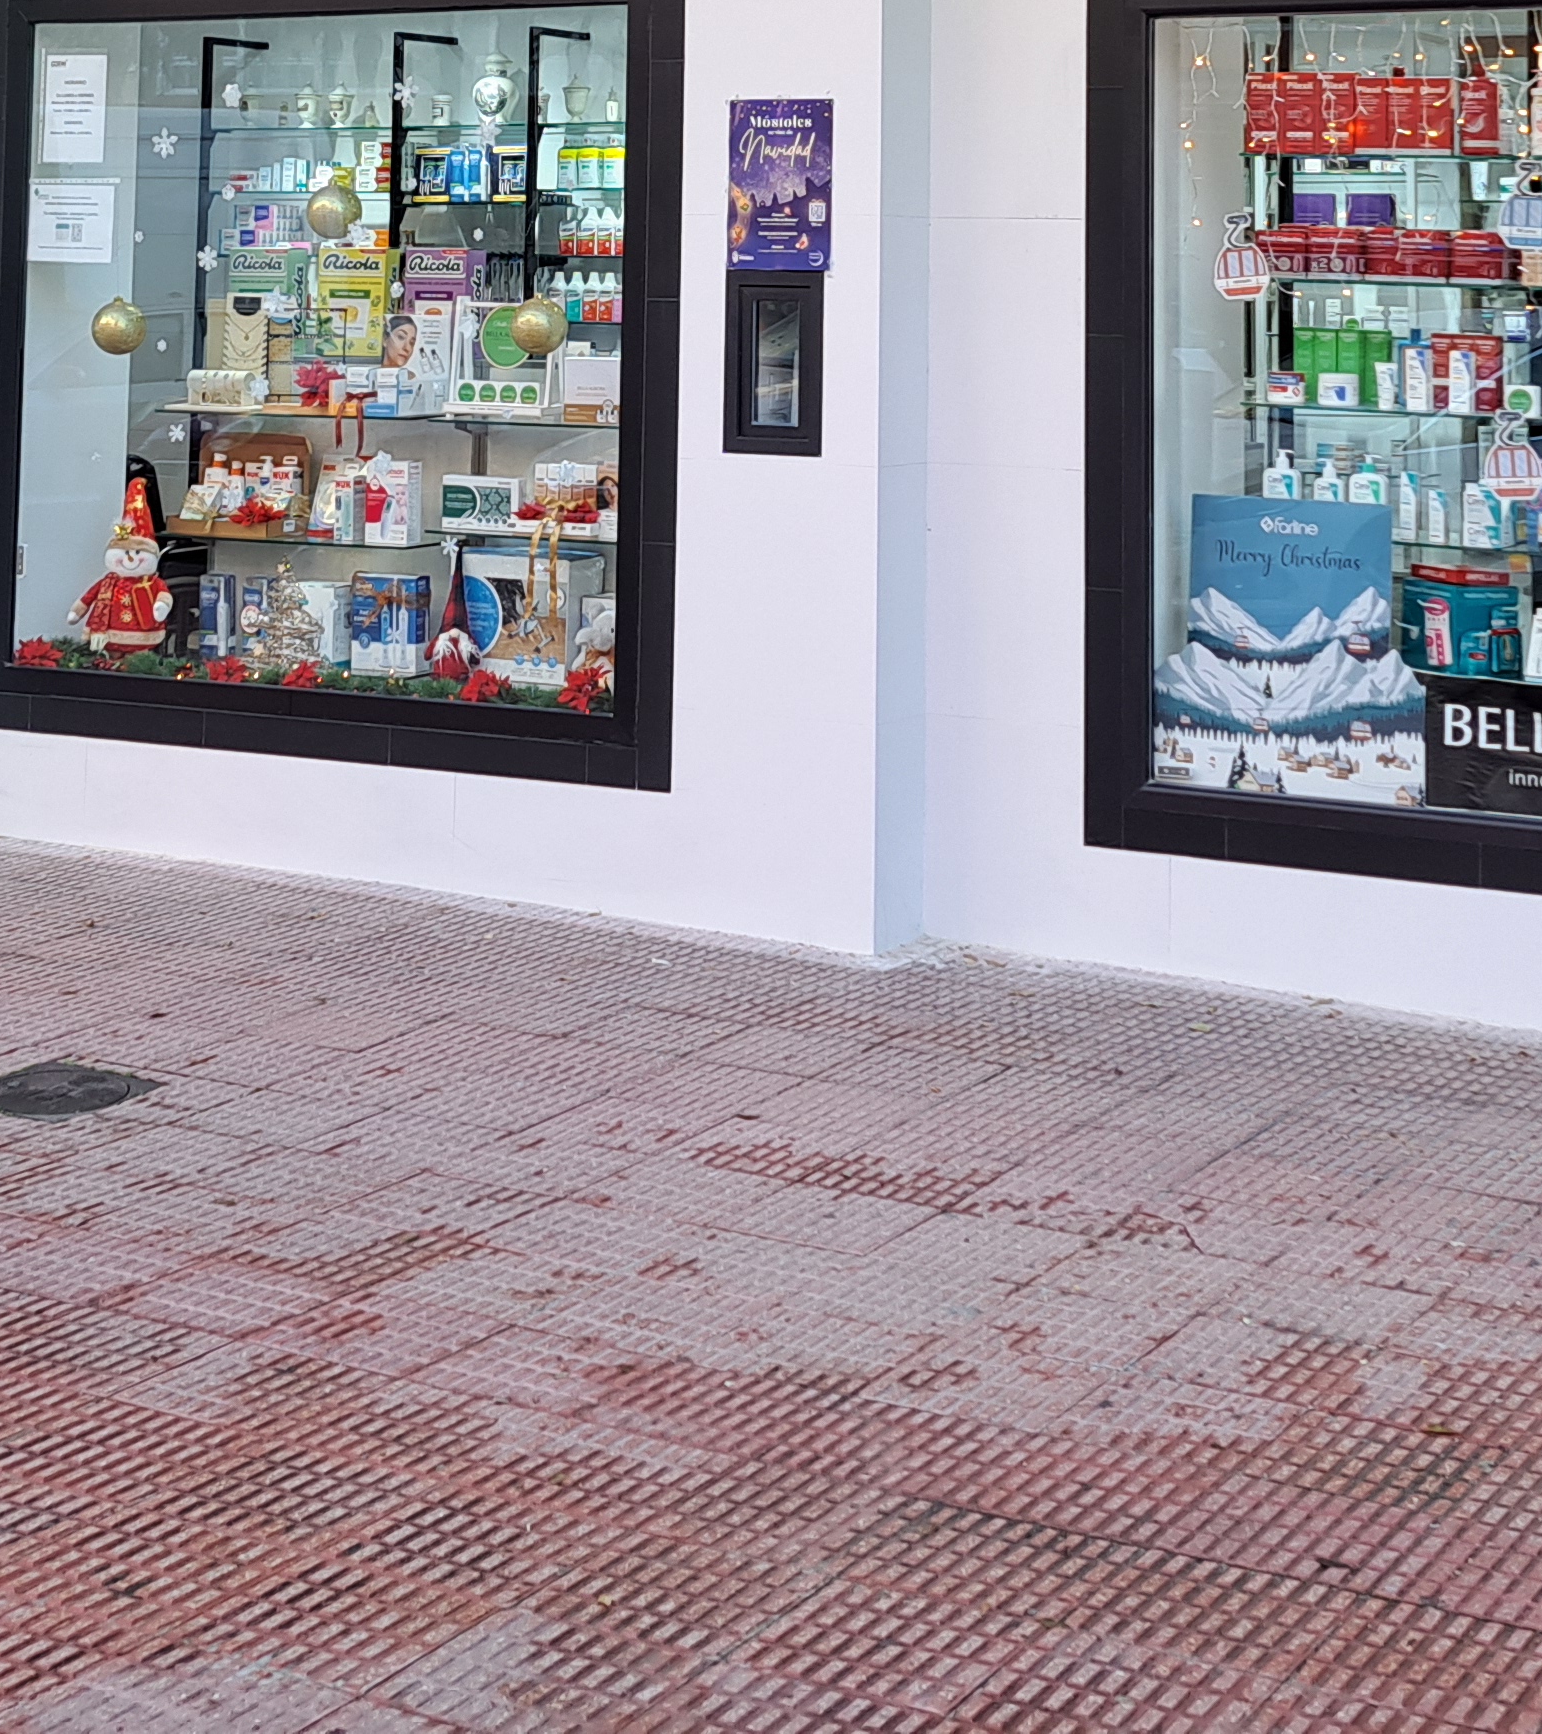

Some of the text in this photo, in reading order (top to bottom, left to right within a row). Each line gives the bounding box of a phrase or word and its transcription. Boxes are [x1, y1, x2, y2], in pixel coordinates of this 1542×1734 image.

[750, 114, 812, 128] Móstoles
[739, 128, 816, 172] Navidad
[233, 252, 283, 271] Ricola
[323, 253, 381, 271] Ricola
[409, 255, 461, 272] Ricola
[1216, 539, 1361, 577] Merry Christmas
